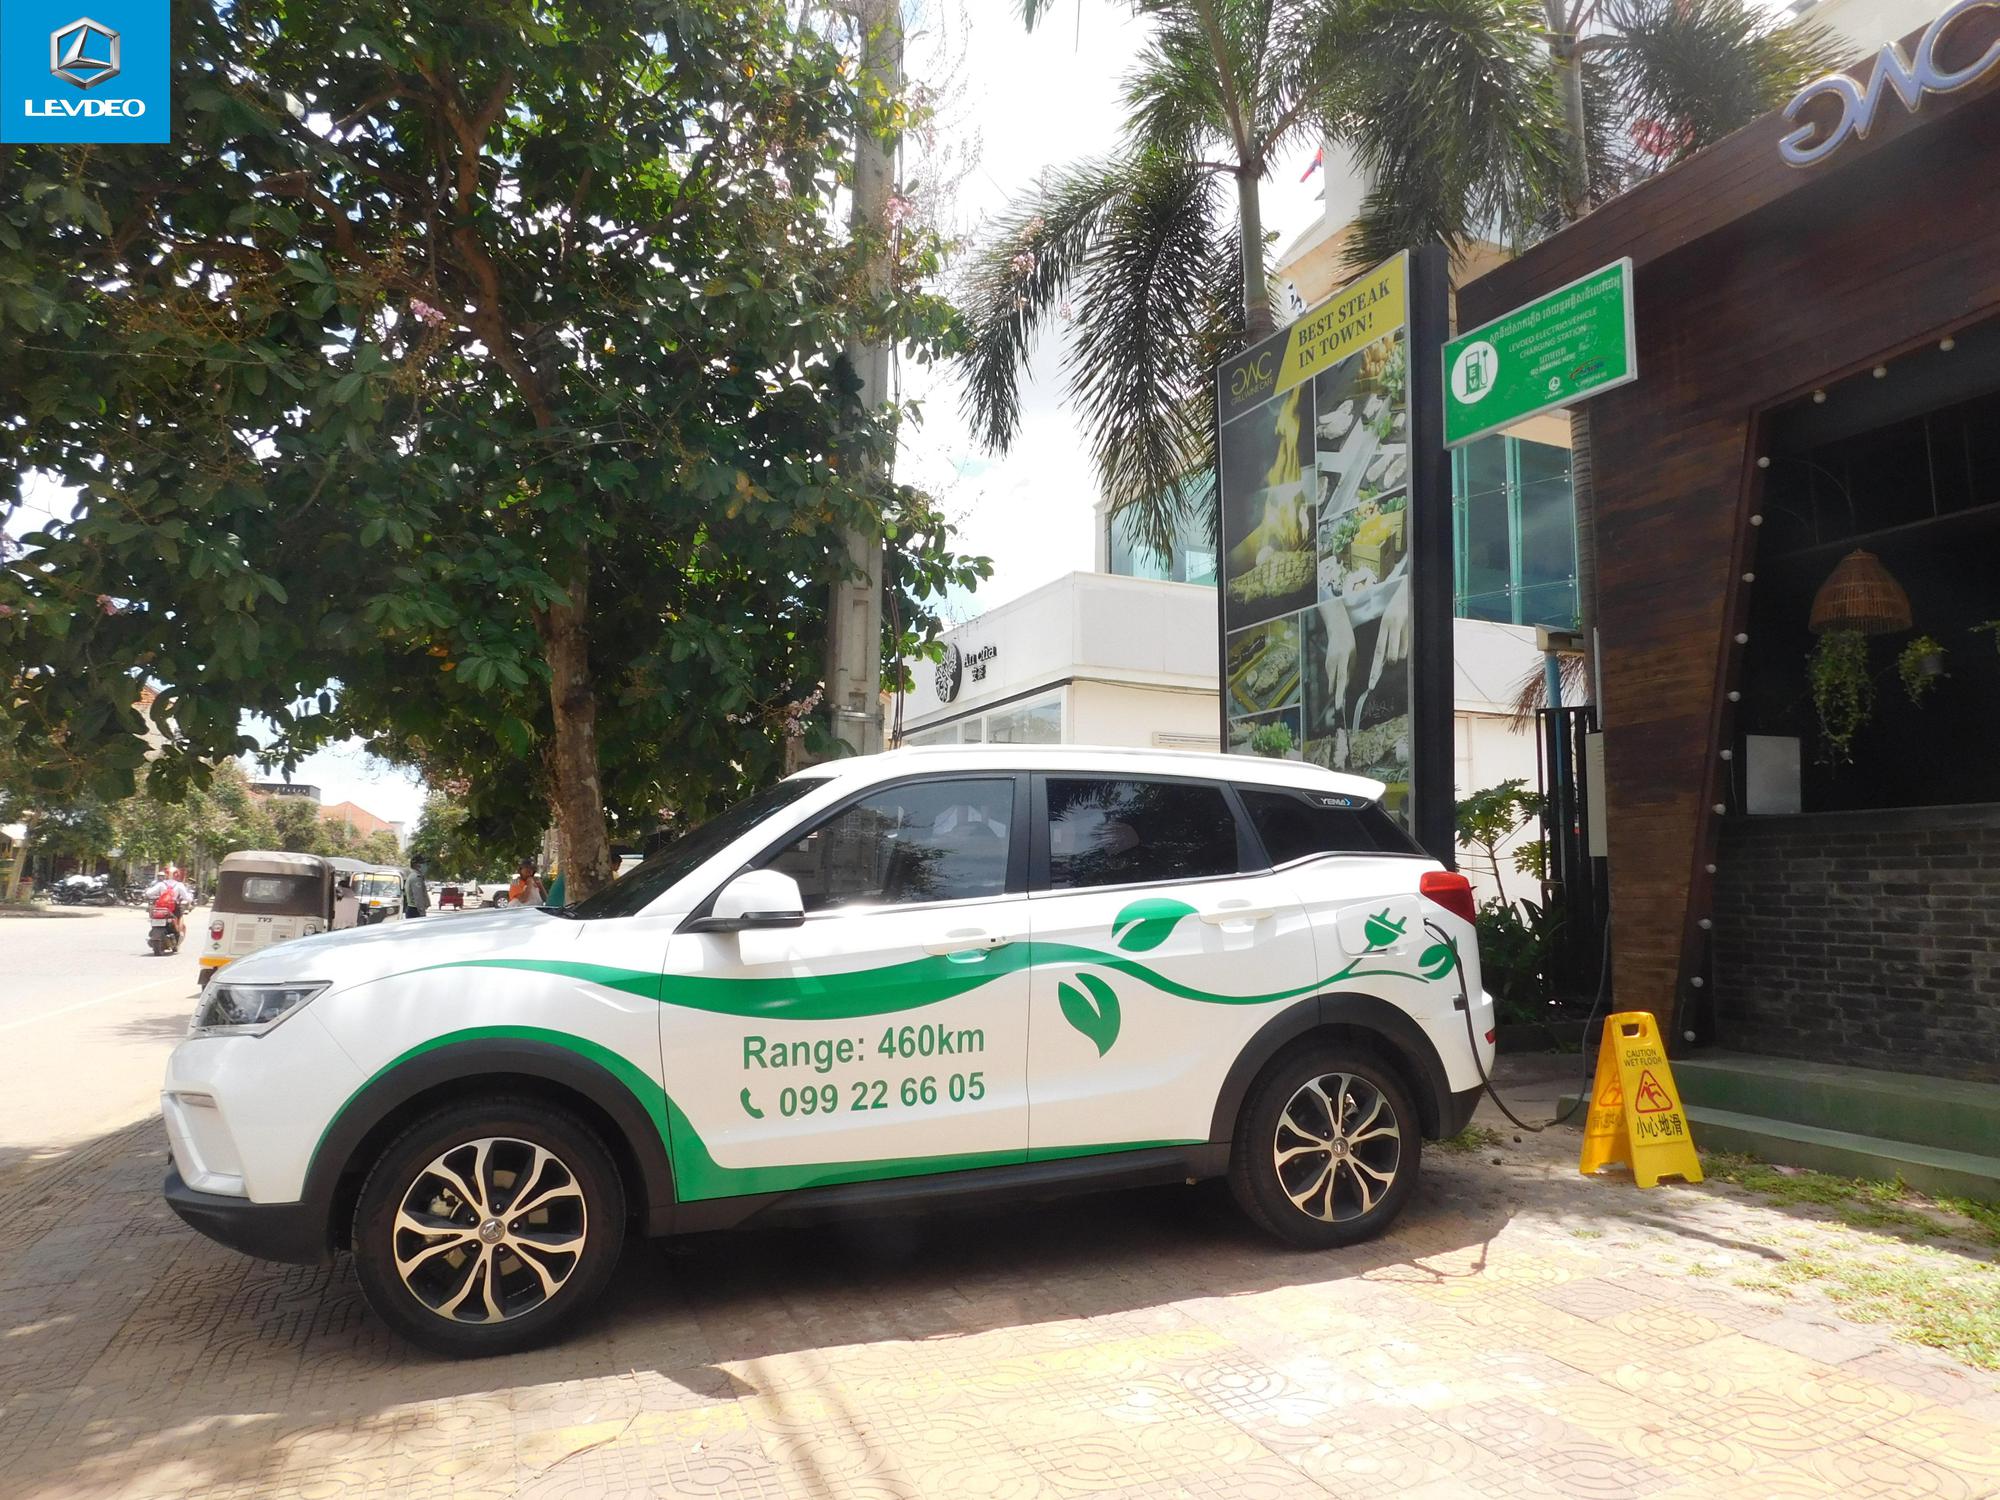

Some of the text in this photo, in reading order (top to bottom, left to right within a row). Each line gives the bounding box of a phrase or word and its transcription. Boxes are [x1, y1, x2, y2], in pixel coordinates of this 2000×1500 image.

[1298, 278, 1391, 347] BEST STEAK
[1535, 320, 1567, 341] ELECTRIC
[1567, 307, 1597, 327] VEHICLE
[1298, 312, 1373, 369] IN TOWN!
[1519, 323, 1587, 359] CHARGING STATION
[1469, 366, 1479, 390] EV
[743, 1023, 985, 1074] Range: 460km
[1624, 1055, 1662, 1067] WET FLOOR
[1626, 1048, 1656, 1058] CAUTION
[779, 1071, 985, 1117] 099 22 66 05
[1636, 1112, 1683, 1138] 小心地滑
